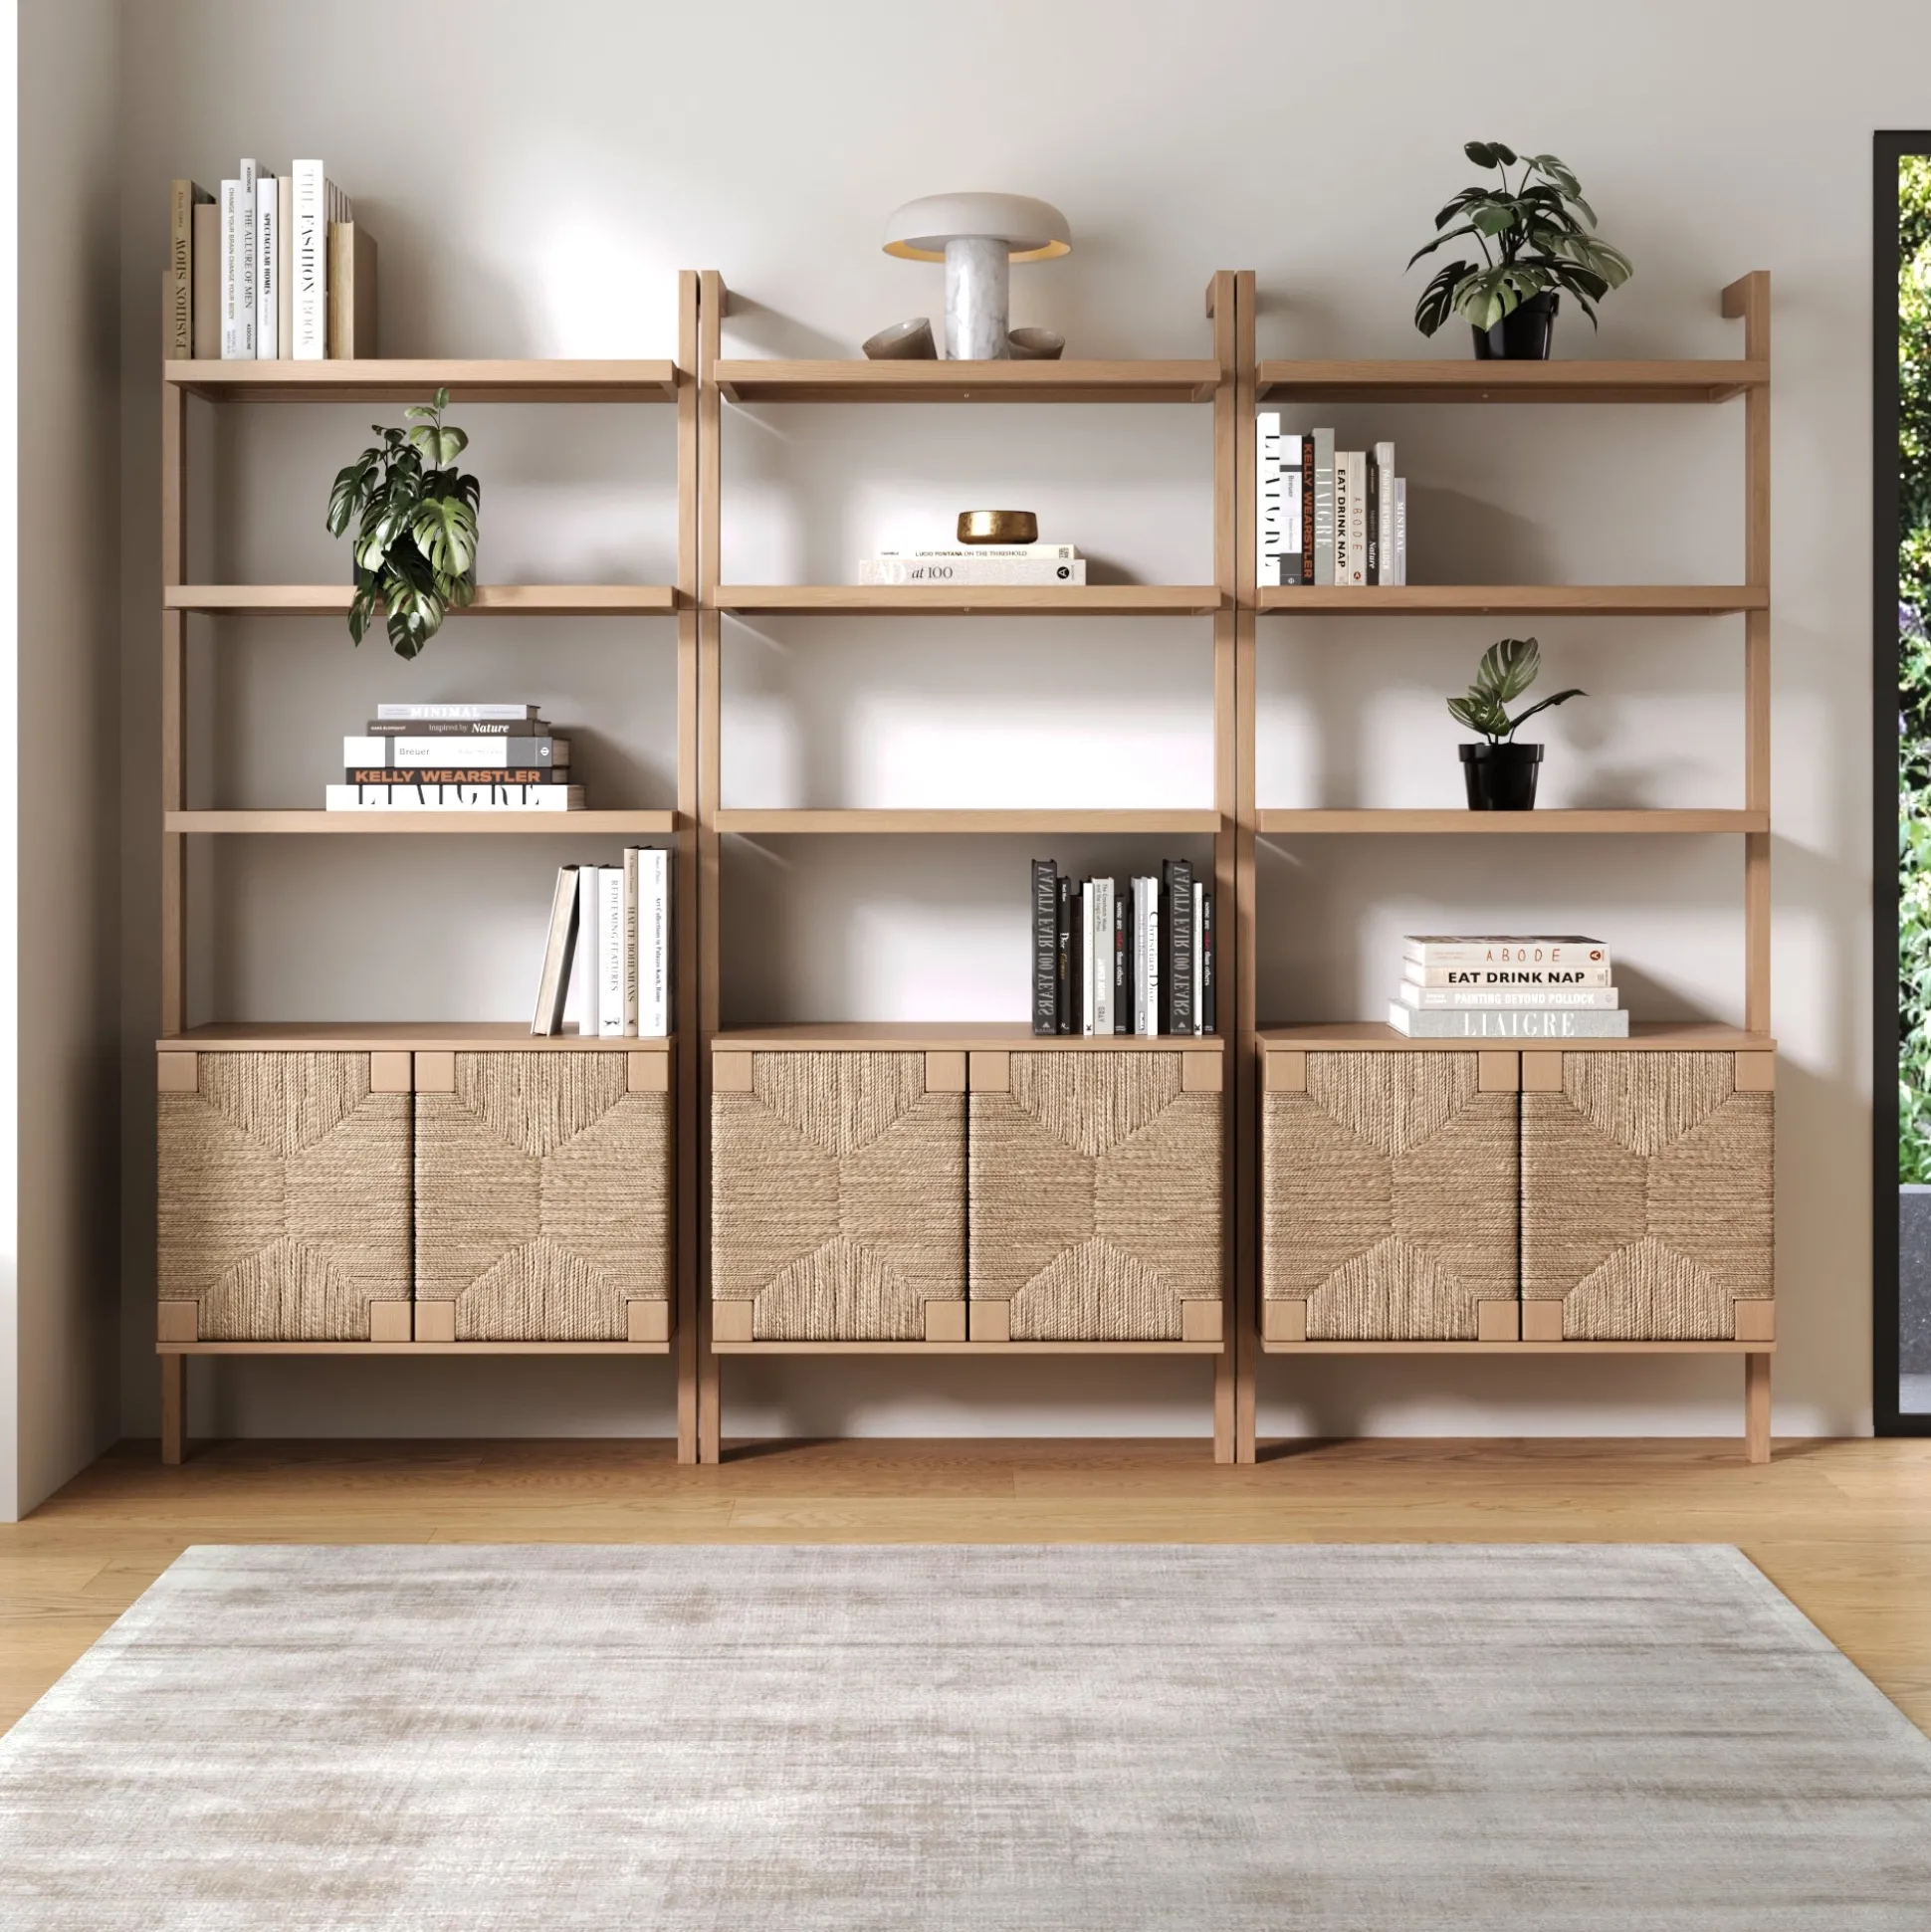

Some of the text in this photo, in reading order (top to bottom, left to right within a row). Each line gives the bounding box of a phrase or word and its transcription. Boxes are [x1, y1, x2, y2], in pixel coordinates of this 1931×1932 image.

[301, 169, 315, 208] THE
[263, 212, 272, 267] SPECTACULAR
[301, 214, 315, 294] FASHION
[245, 271, 253, 284] OF
[263, 268, 272, 295] HOMES
[175, 237, 187, 349] FASHION SHOW
[1316, 468, 1333, 547] LIAIGRE
[911, 566, 954, 579] at 100
[410, 707, 481, 718] MINIMAL
[429, 723, 510, 734] Inspired by Nature
[354, 770, 540, 782] KELLY WEARSTLER
[1116, 902, 1125, 919] some
[1116, 919, 1125, 930] are
[610, 880, 619, 991] REDEEMING FEATURES
[1060, 932, 1069, 949] Dior
[1116, 951, 1125, 966] than
[1116, 966, 1125, 986] others
[1448, 972, 1481, 983] EAT
[1486, 972, 1543, 983] DRINK
[1548, 972, 1586, 983] NAP
[1454, 994, 1502, 1004] PAINTING
[1505, 994, 1545, 1004] BEYOND
[1549, 994, 1595, 1004] POLLOCK
[1463, 1012, 1575, 1036] LIAIGRE
